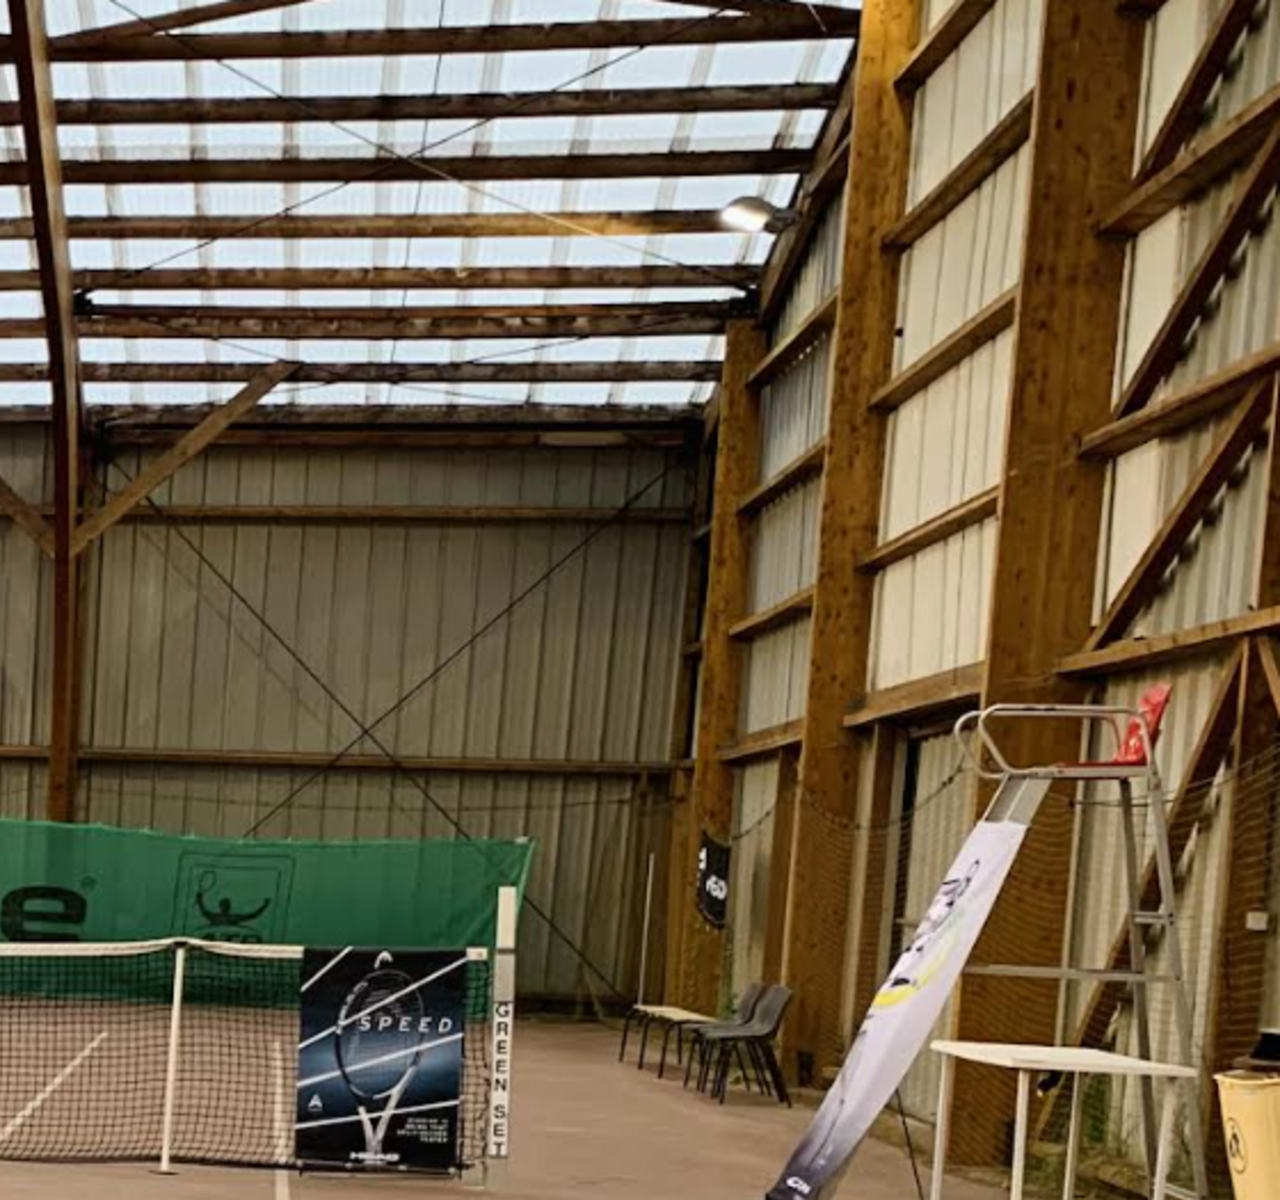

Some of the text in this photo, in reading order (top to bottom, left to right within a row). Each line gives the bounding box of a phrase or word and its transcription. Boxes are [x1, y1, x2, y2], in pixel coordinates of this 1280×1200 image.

[358, 1016, 453, 1033] SPEED
[493, 1002, 510, 1156] GREEN SET
